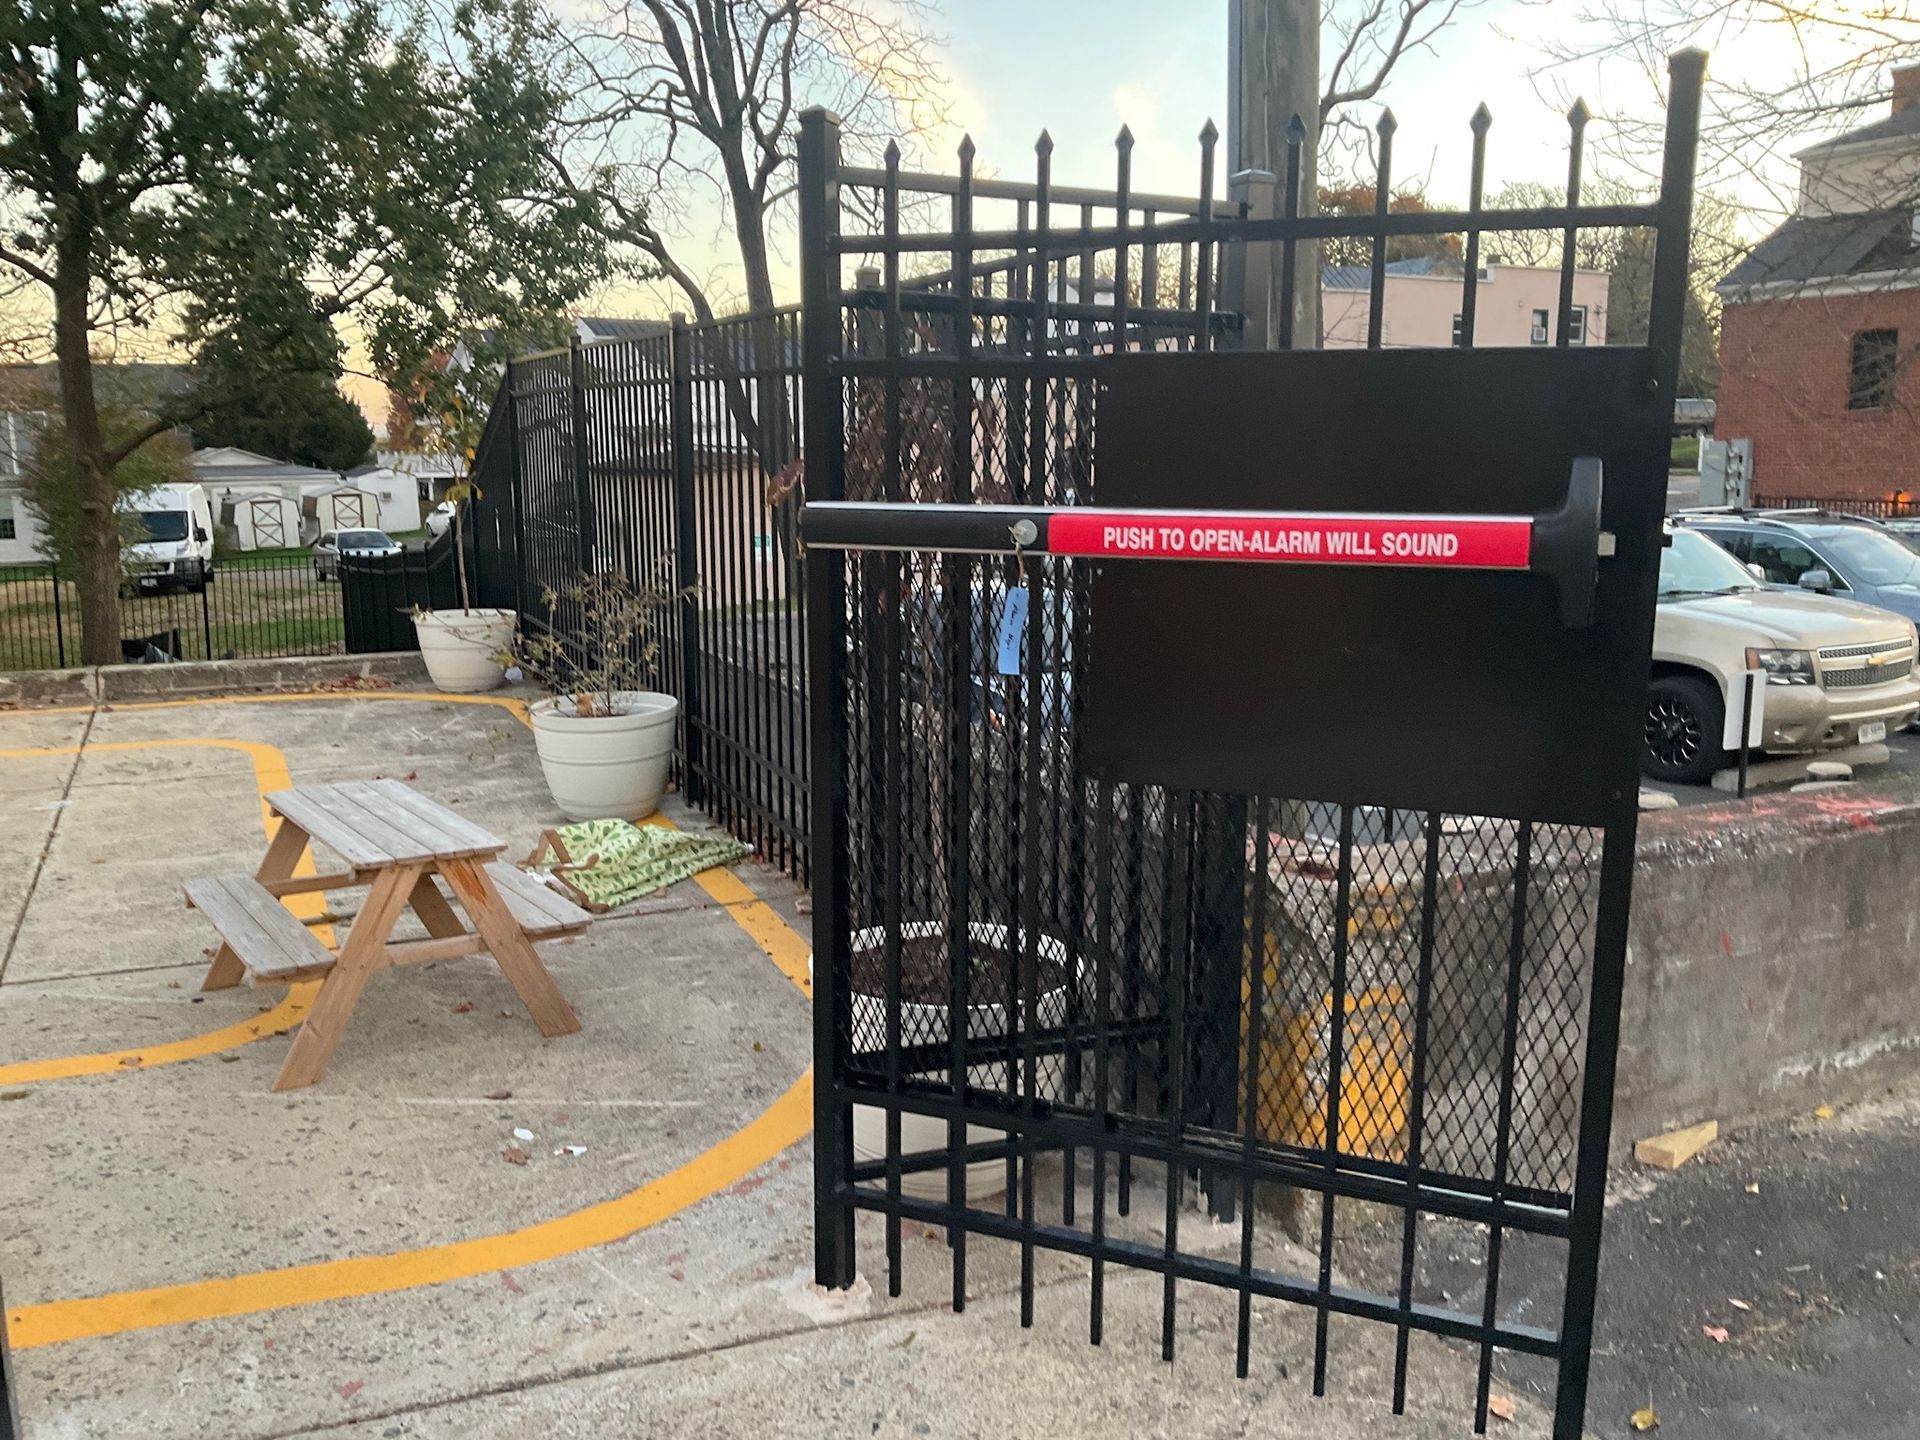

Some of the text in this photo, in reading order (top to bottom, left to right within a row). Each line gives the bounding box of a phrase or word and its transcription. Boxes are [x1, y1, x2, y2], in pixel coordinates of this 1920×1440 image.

[1103, 527, 1458, 557] PUSH TO OPEN-ALARM WILL SOUND
